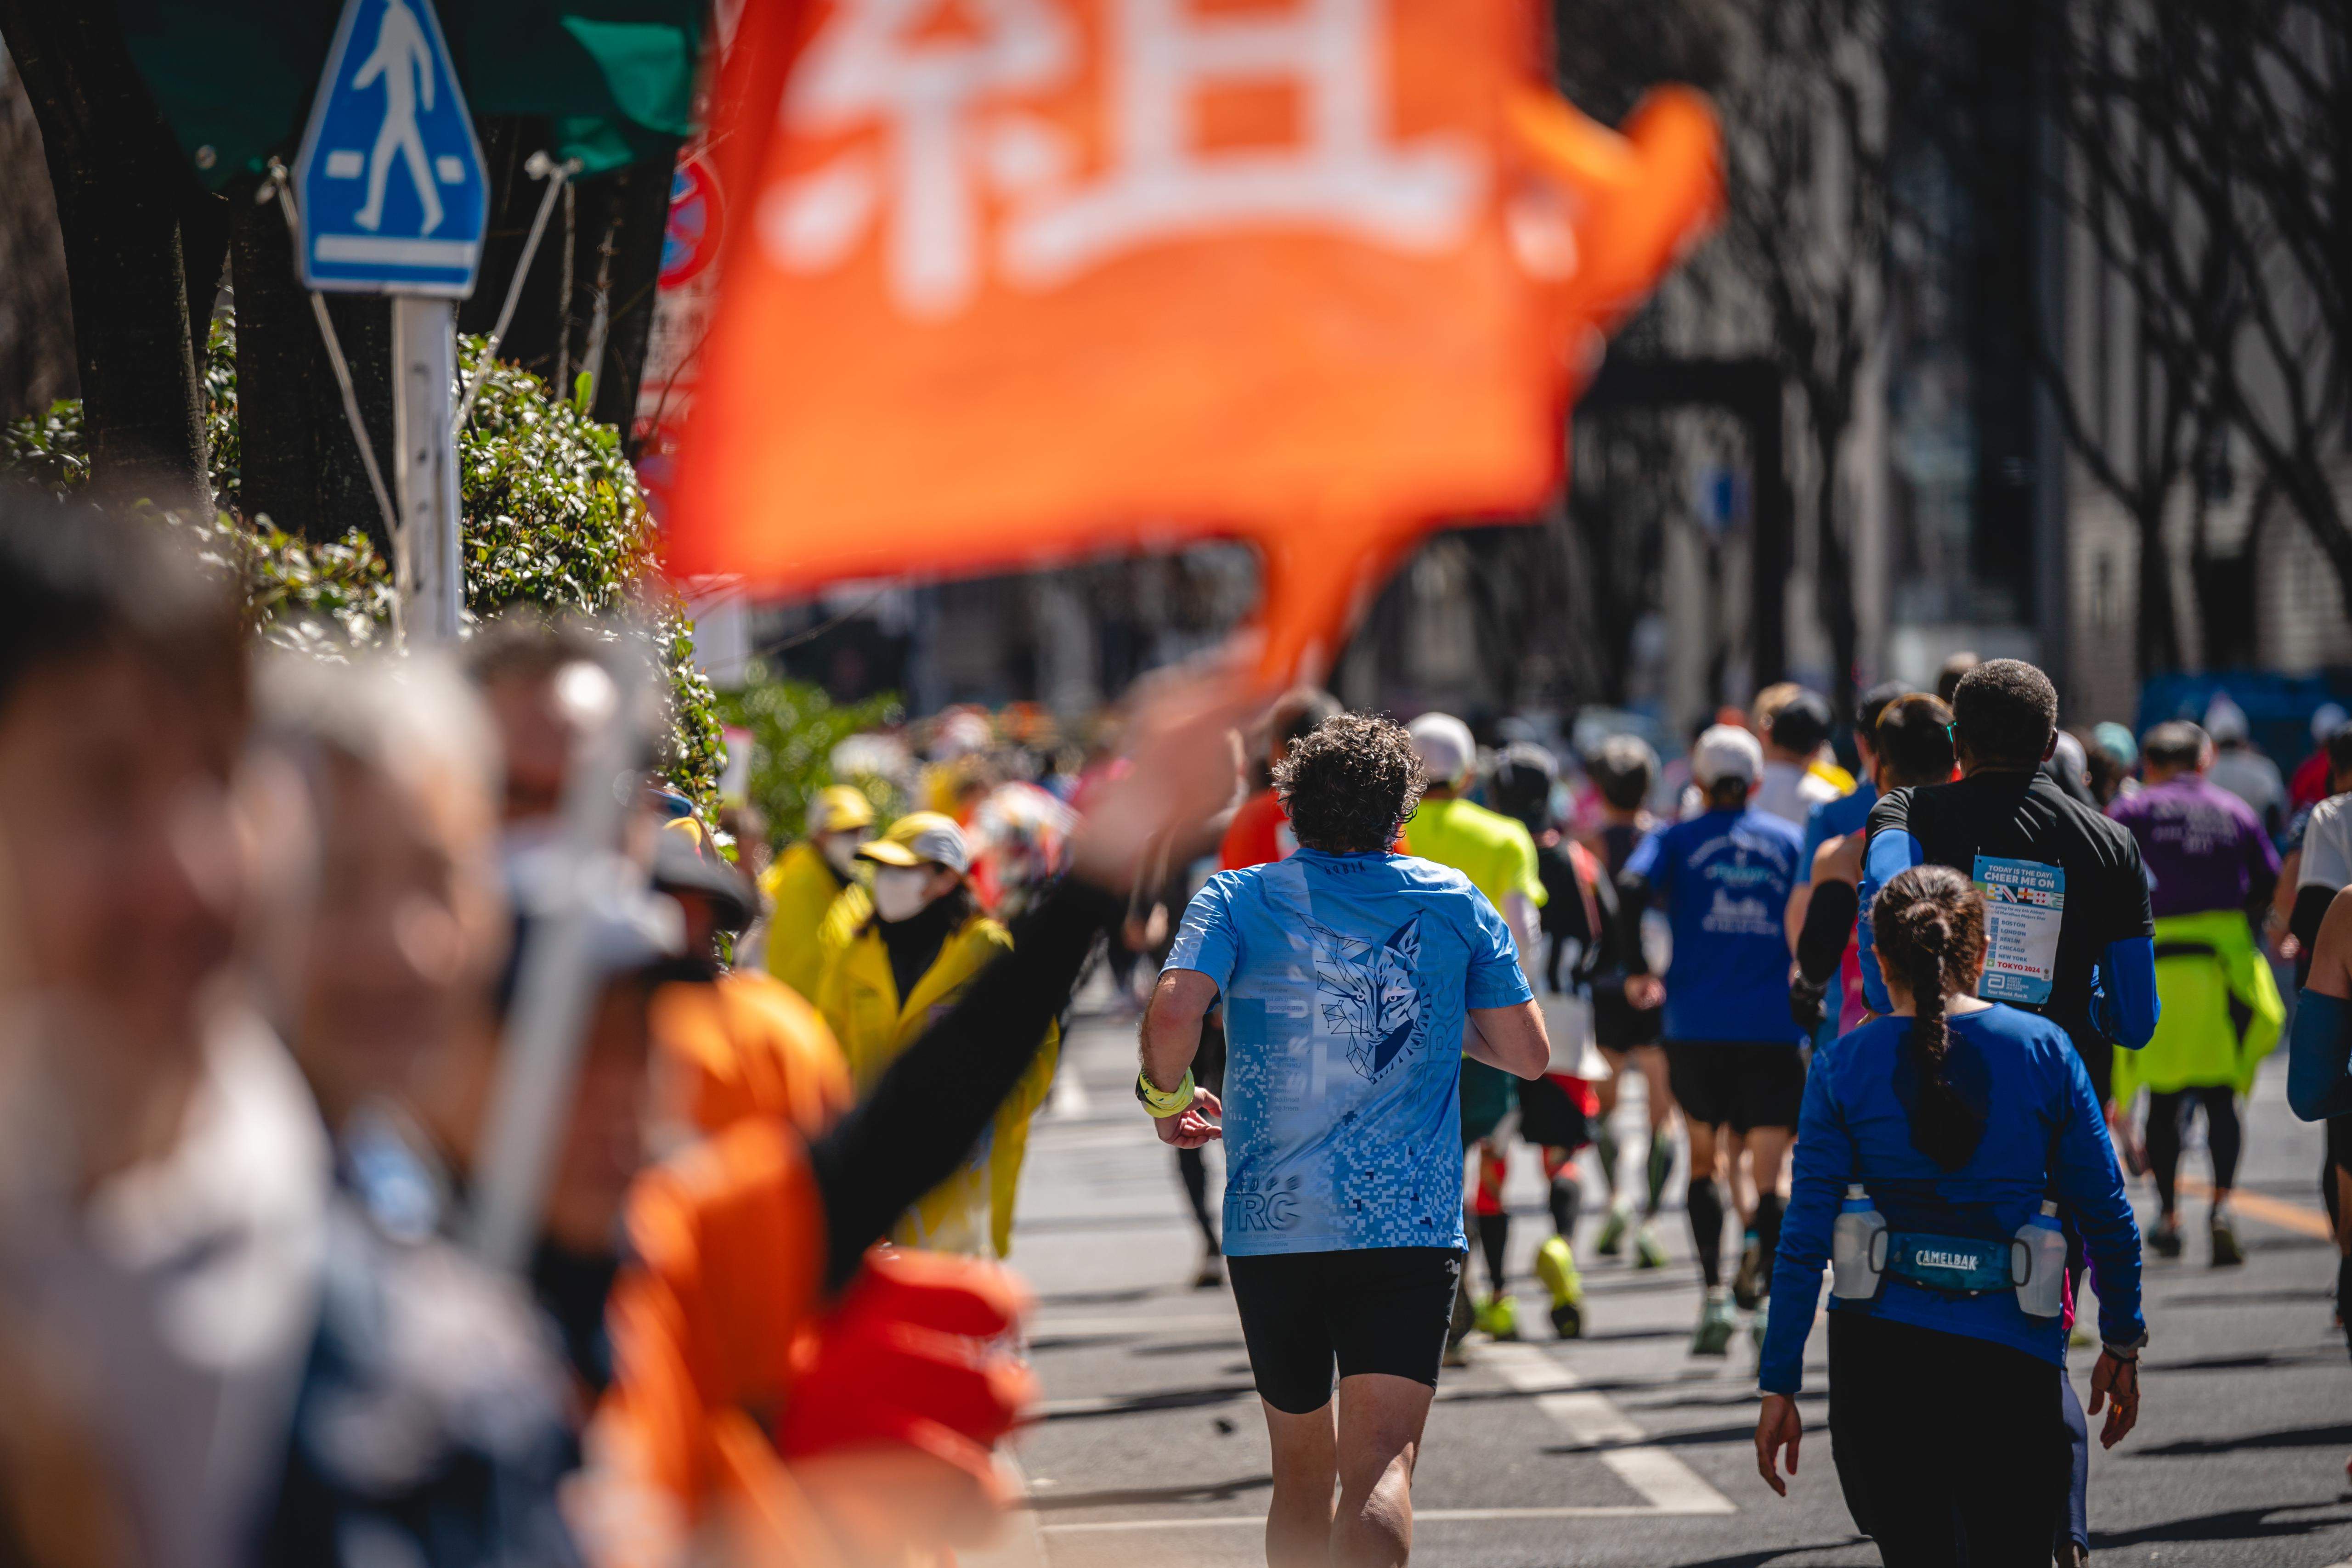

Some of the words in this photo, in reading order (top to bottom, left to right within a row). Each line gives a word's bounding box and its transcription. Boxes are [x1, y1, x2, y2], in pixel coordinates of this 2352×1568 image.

[1988, 865, 2013, 873] TODAY
[1984, 872, 2018, 884] CHEER
[2021, 876, 2036, 886] ME
[2038, 879, 2054, 888] ON
[1997, 961, 2023, 970] TOKYO
[1915, 1249, 1977, 1271] CAMELBAK
